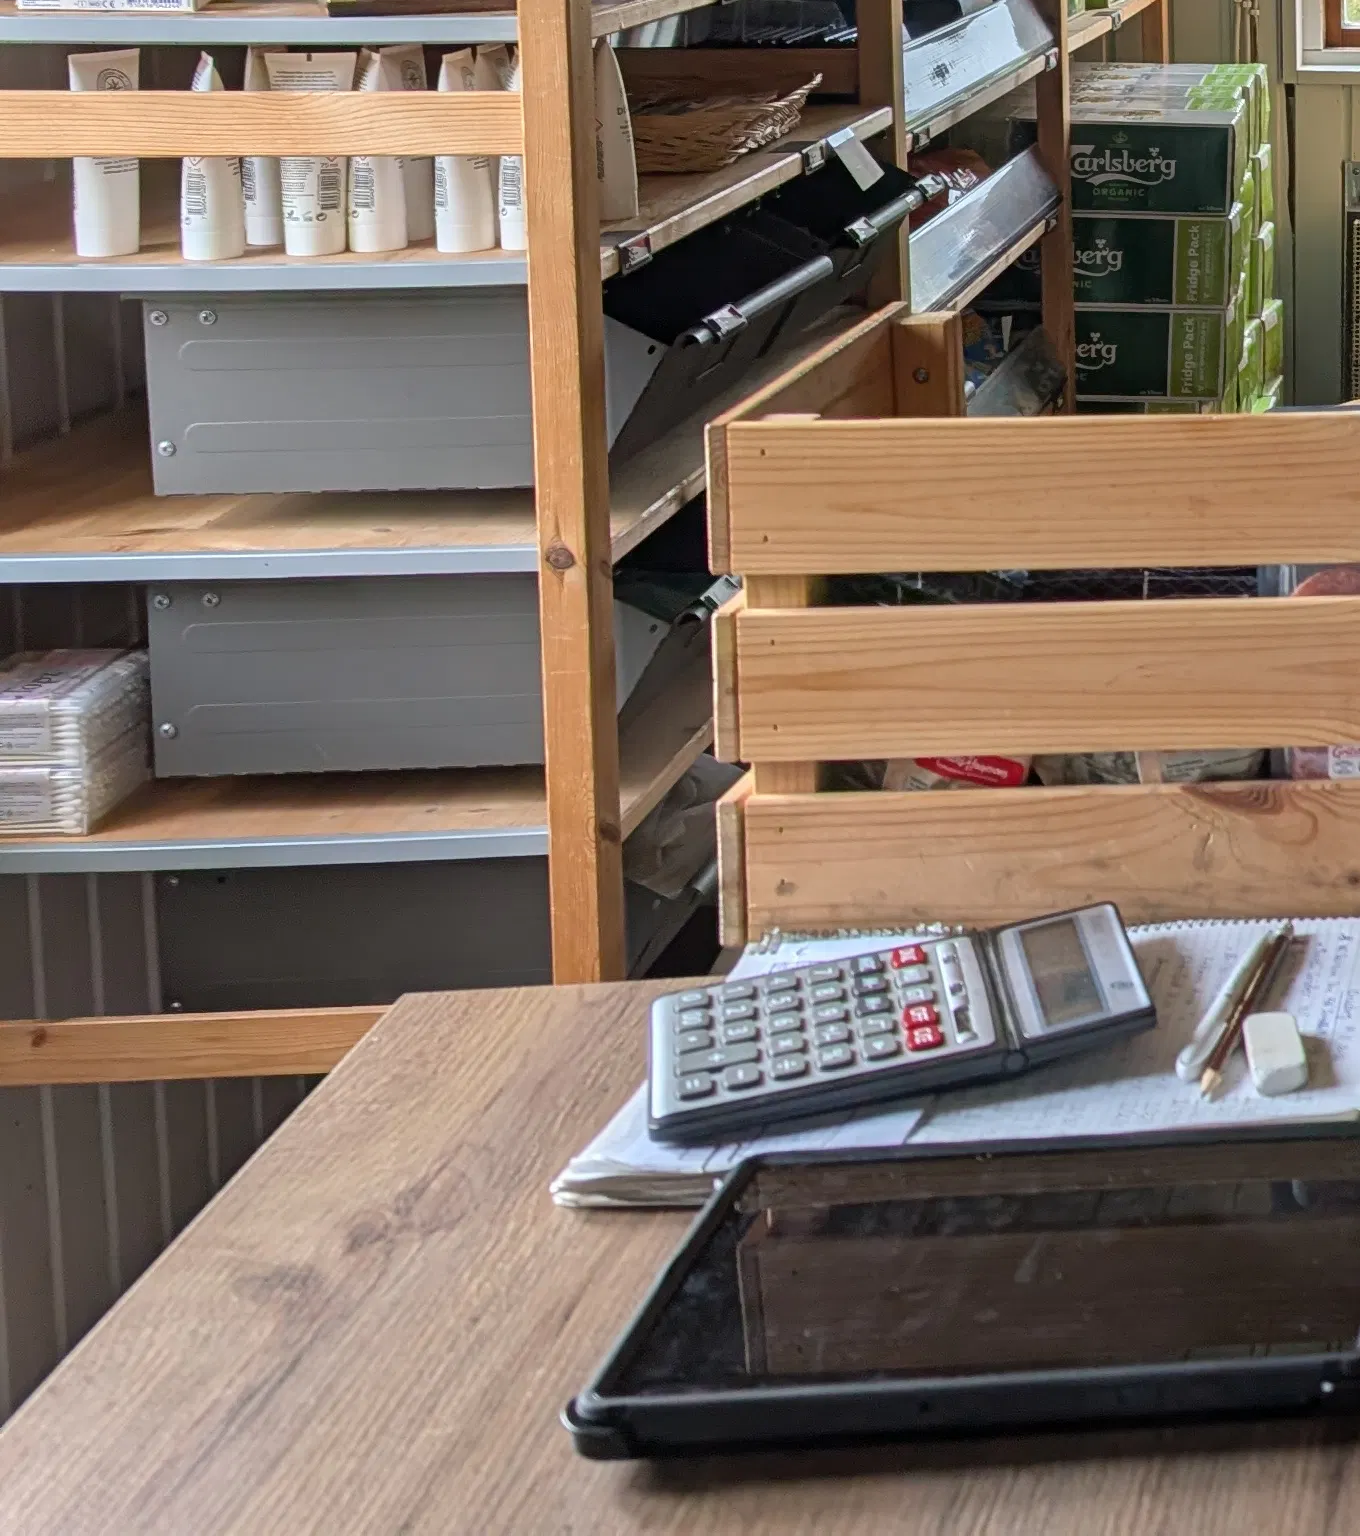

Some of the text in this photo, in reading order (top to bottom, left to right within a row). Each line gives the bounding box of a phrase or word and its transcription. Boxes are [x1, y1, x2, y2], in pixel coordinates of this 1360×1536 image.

[1092, 187, 1145, 198] ORGANIC
[1187, 225, 1200, 302] Fridge Pack
[1181, 351, 1194, 395] Fridge
